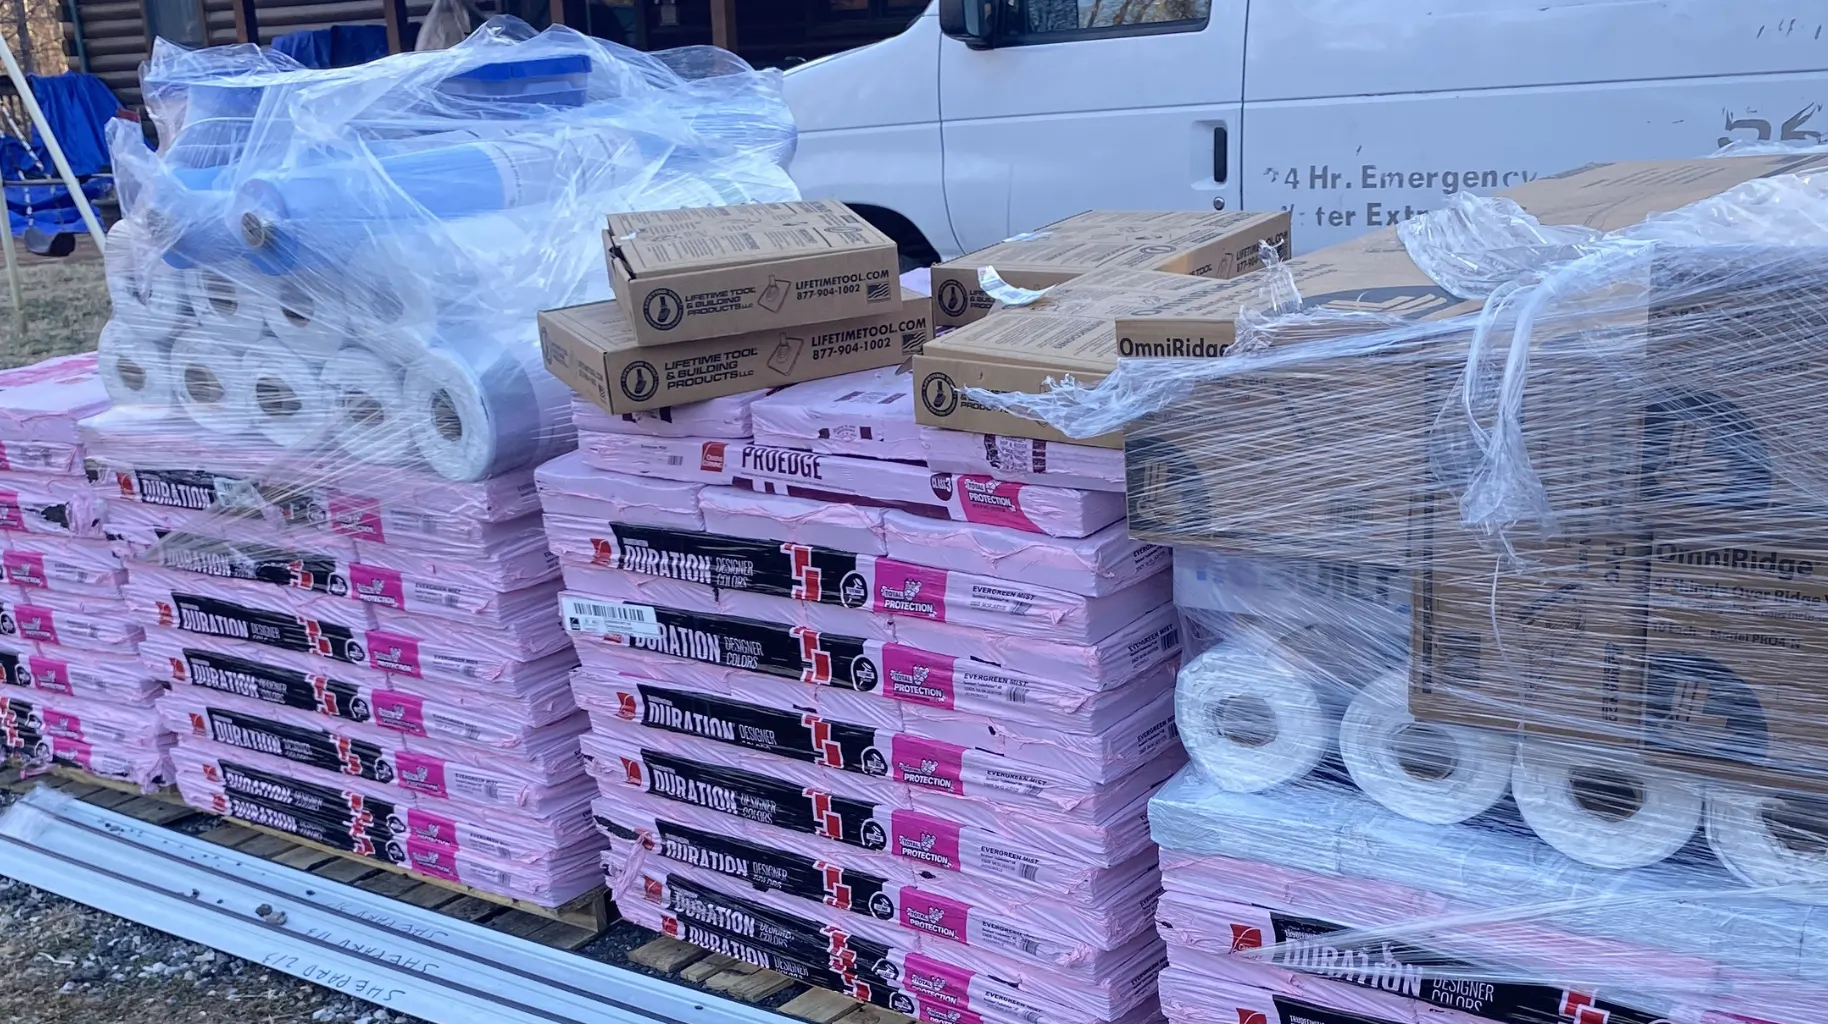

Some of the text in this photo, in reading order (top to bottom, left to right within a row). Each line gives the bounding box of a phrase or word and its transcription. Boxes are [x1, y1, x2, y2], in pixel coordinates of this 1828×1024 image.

[1309, 165, 1352, 189] Hr.
[795, 269, 890, 291] LIFETIMETOOL.COM
[685, 287, 757, 302] LIFETIME TOOL
[695, 296, 742, 308] BUILDING
[796, 284, 861, 300] 877-904-1002
[687, 303, 741, 316] PRODUCTS
[811, 318, 927, 348] LIFETIMETOOL.COM
[812, 337, 891, 360] 877-904-1002
[664, 347, 758, 371] LIFETIME TOOL
[666, 360, 738, 381] & BUILDING
[667, 370, 754, 390] PRODUCTS LLC
[742, 446, 829, 480] PROEDGE
[143, 479, 213, 509] DURATION
[969, 492, 1012, 507] PROTECTION
[623, 544, 754, 584] DURATION DESIGNER
[1656, 543, 1814, 581] OmniRidge
[716, 573, 748, 588] COLORS
[884, 588, 905, 599] TOTAL
[972, 585, 1036, 601] EVERGREEN MIST
[884, 600, 934, 614] PROTECTION
[182, 608, 249, 639] DURATION
[725, 636, 763, 656] DESIGNER
[726, 654, 758, 669] COLORS
[193, 664, 259, 699] DURATION
[893, 672, 912, 684] TOTAL
[964, 673, 1029, 688] EVERGREEN MIST
[894, 683, 943, 698] PROTECTION
[648, 700, 777, 745] DURATION DESIGNER
[214, 719, 283, 755] DURATION
[904, 772, 951, 789] PROTECTION
[653, 769, 777, 815] DURATION DESIGNER
[902, 837, 920, 850] TOTAL
[665, 839, 788, 882] DURATION DESIGNER
[902, 847, 949, 863] PROTECTION
[981, 845, 1022, 861] EVERGREEN
[1022, 855, 1039, 865] MIST
[674, 890, 755, 938] DURATION
[910, 910, 928, 923] TOTAL
[910, 919, 955, 938] PROTECTION
[689, 926, 770, 968] DURATION
[1284, 937, 1495, 1002] DURATION DESIGNER
[303, 964, 406, 1001] SHEPARD
[1431, 989, 1483, 1011] COLORS
